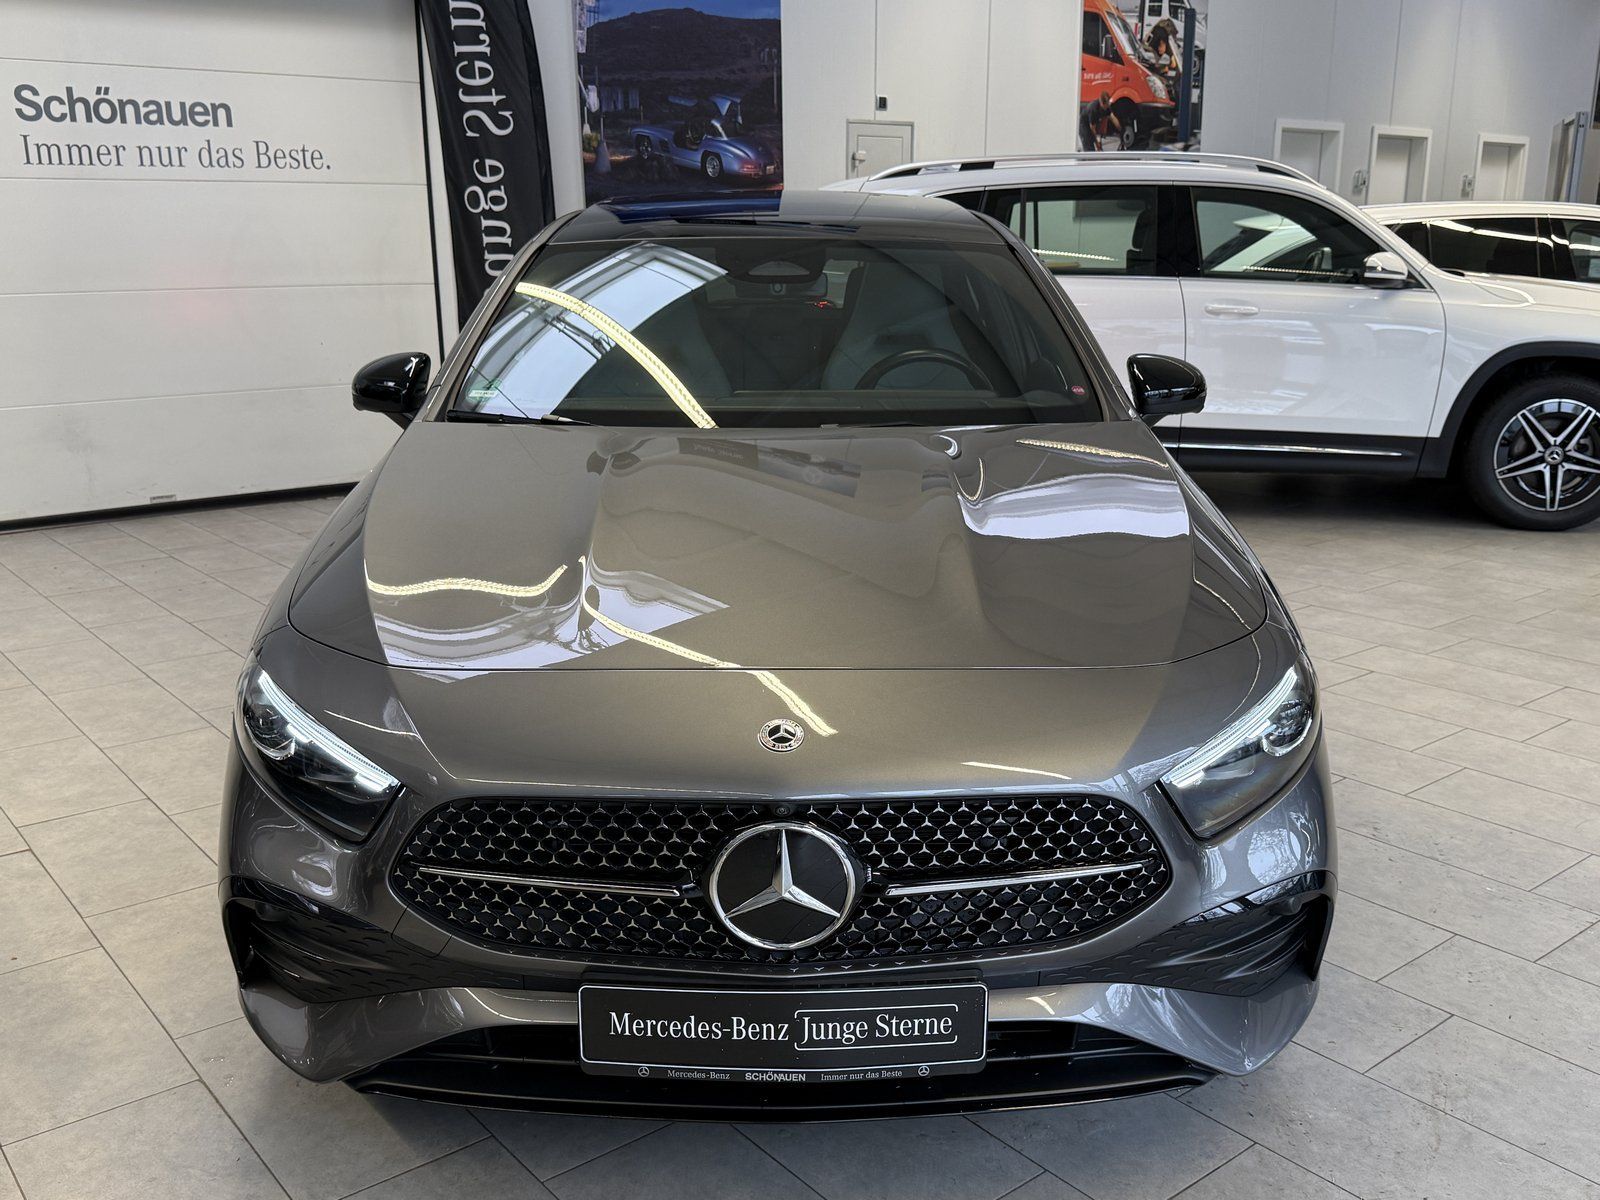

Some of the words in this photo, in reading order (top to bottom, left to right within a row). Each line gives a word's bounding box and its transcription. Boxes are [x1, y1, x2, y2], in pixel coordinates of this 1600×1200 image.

[13, 83, 234, 128] Schönauen
[20, 134, 126, 167] Immer
[136, 144, 189, 168] nur
[198, 139, 245, 169] das
[252, 140, 332, 170] Beste.
[609, 1011, 790, 1041] Mercedes-Benz
[800, 1016, 869, 1045] Junge
[875, 1013, 953, 1038] Sterne
[667, 1069, 731, 1080] Mercedes-Benz
[745, 1071, 806, 1082] SCHÖNAUEN
[820, 1073, 848, 1081] Immer
[865, 1070, 880, 1079] das
[881, 1069, 903, 1078] Beste
